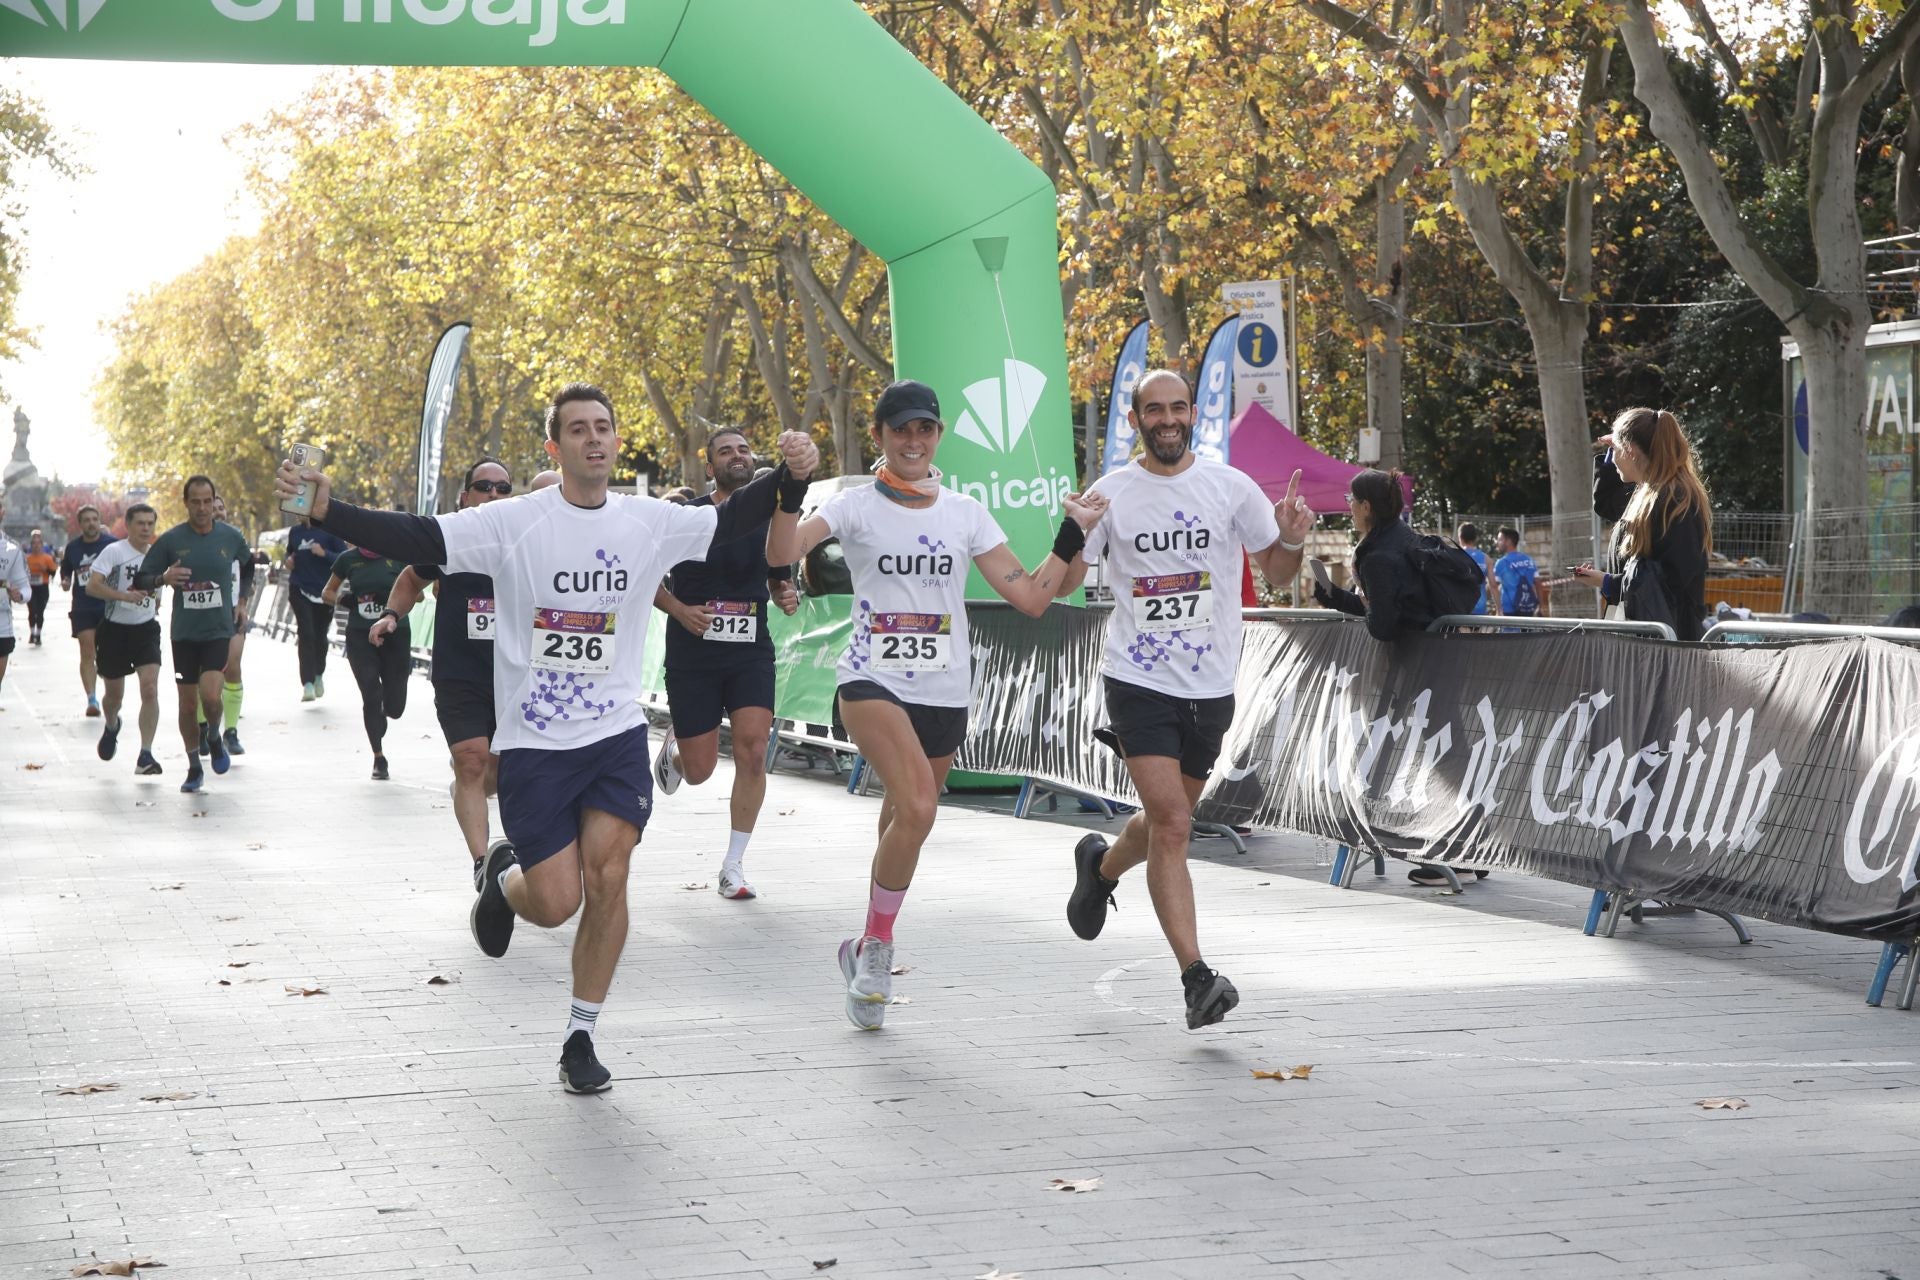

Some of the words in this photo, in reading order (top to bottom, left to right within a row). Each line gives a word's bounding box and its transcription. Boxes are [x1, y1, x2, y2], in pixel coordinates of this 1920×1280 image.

[1134, 528, 1210, 553] curia
[878, 554, 953, 576] curia
[553, 569, 628, 594] curia
[188, 591, 214, 603] 487
[1145, 594, 1199, 621] 237
[712, 616, 749, 634] 912
[543, 633, 603, 661] 236
[881, 636, 937, 660] 235
